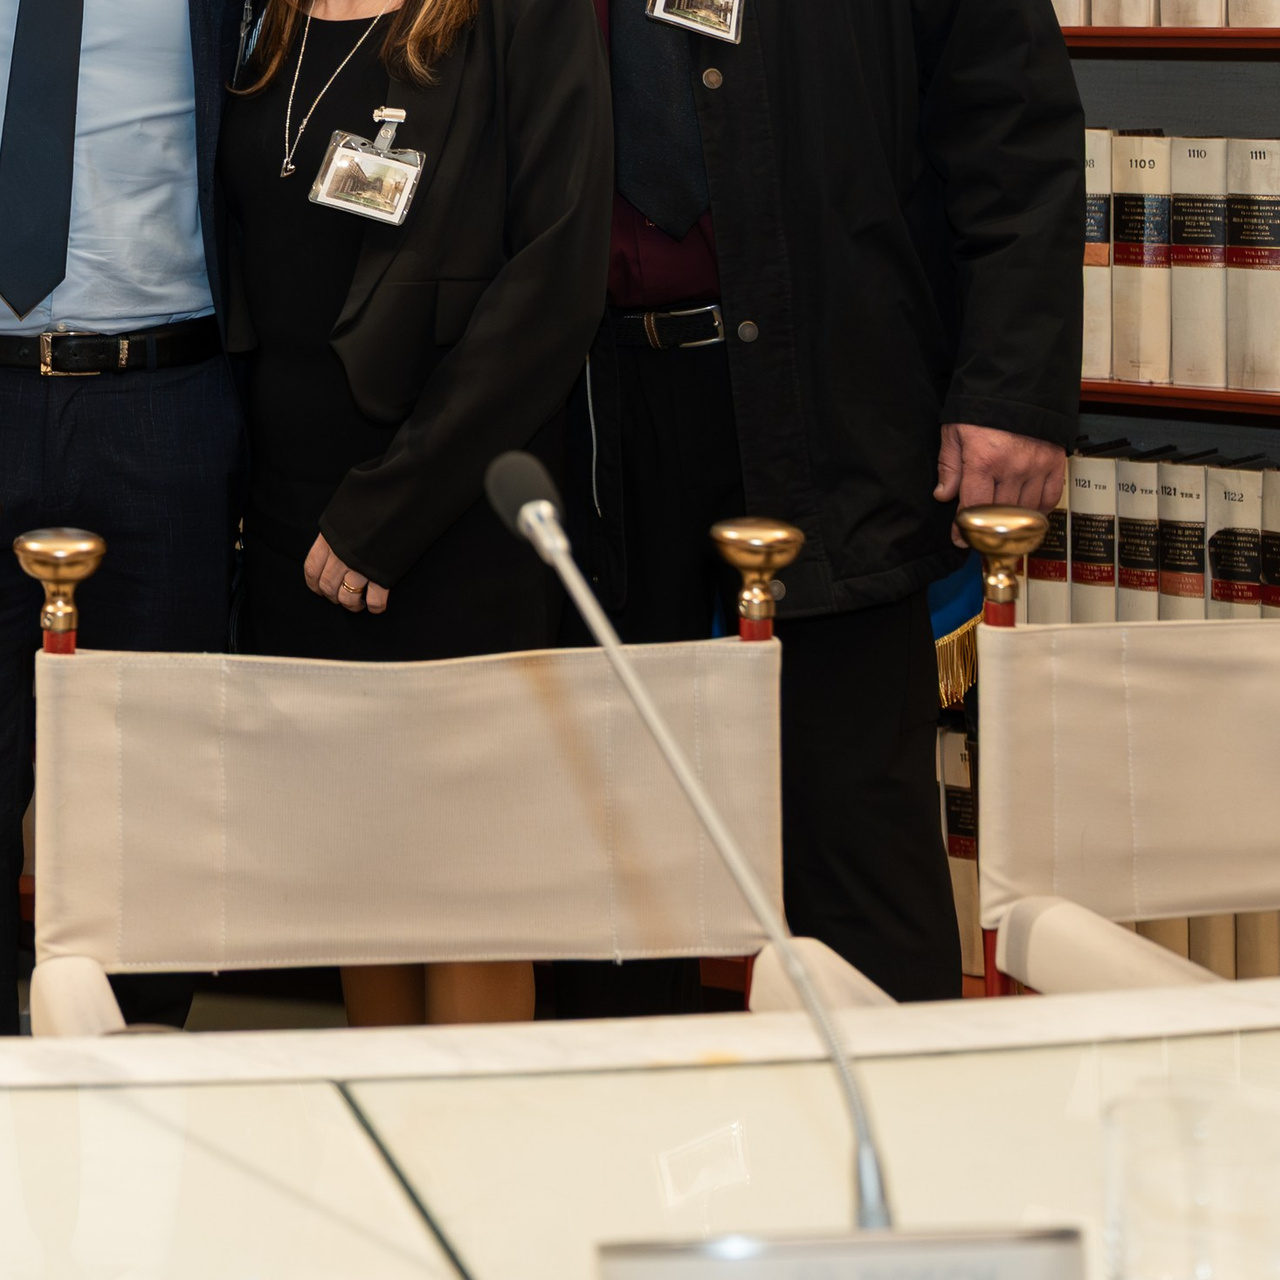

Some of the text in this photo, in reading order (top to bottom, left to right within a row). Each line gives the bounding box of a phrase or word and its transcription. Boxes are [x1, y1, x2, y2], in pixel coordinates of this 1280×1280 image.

[1189, 149, 1206, 158] 1110
[1251, 151, 1265, 159] 1111
[1130, 159, 1155, 168] 1109
[1075, 478, 1090, 488] 1121
[1161, 485, 1176, 496] 1121
[1224, 491, 1243, 502] 1122
